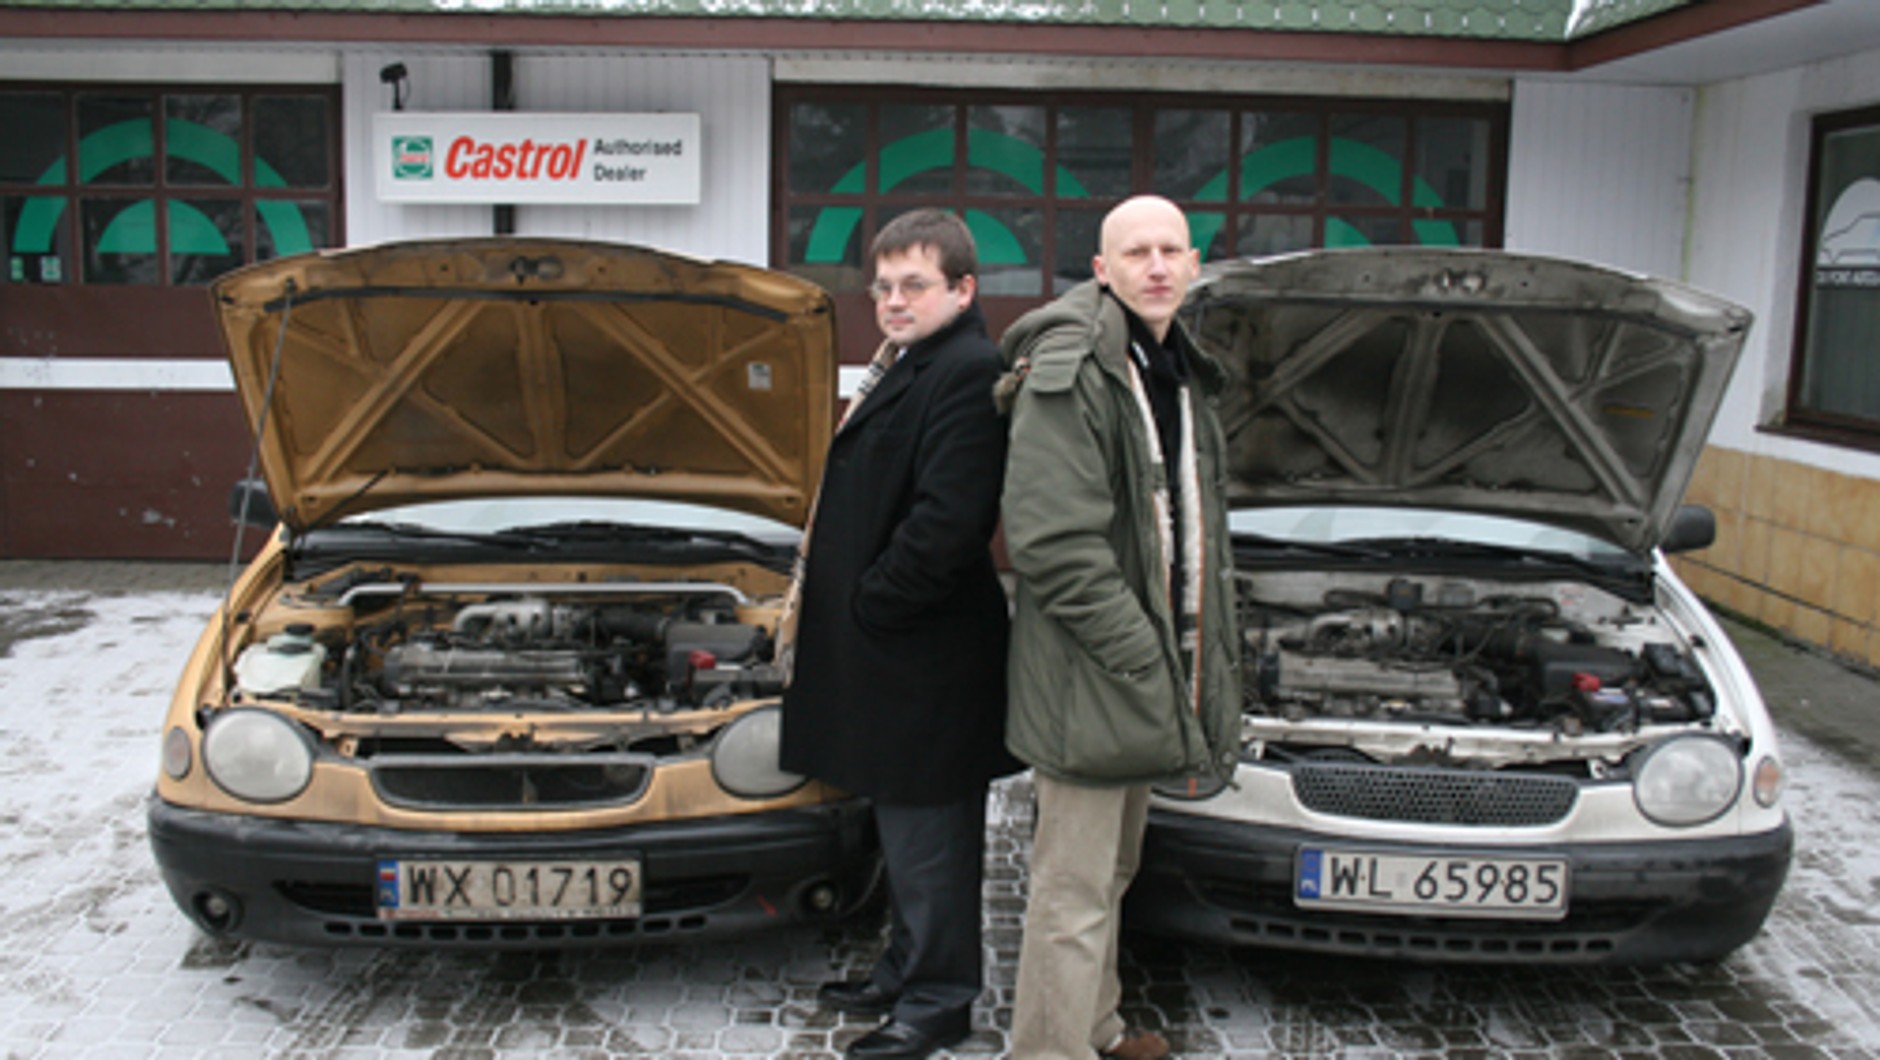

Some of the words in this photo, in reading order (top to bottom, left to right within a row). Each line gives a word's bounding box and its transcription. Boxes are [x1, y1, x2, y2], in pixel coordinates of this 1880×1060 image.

[445, 135, 588, 181] Castrol
[594, 138, 683, 156] Authorised
[594, 163, 647, 182] Dealer
[408, 865, 472, 906] WX
[492, 866, 633, 908] 01719
[1330, 856, 1393, 899] WL
[1413, 860, 1559, 904] 65985
